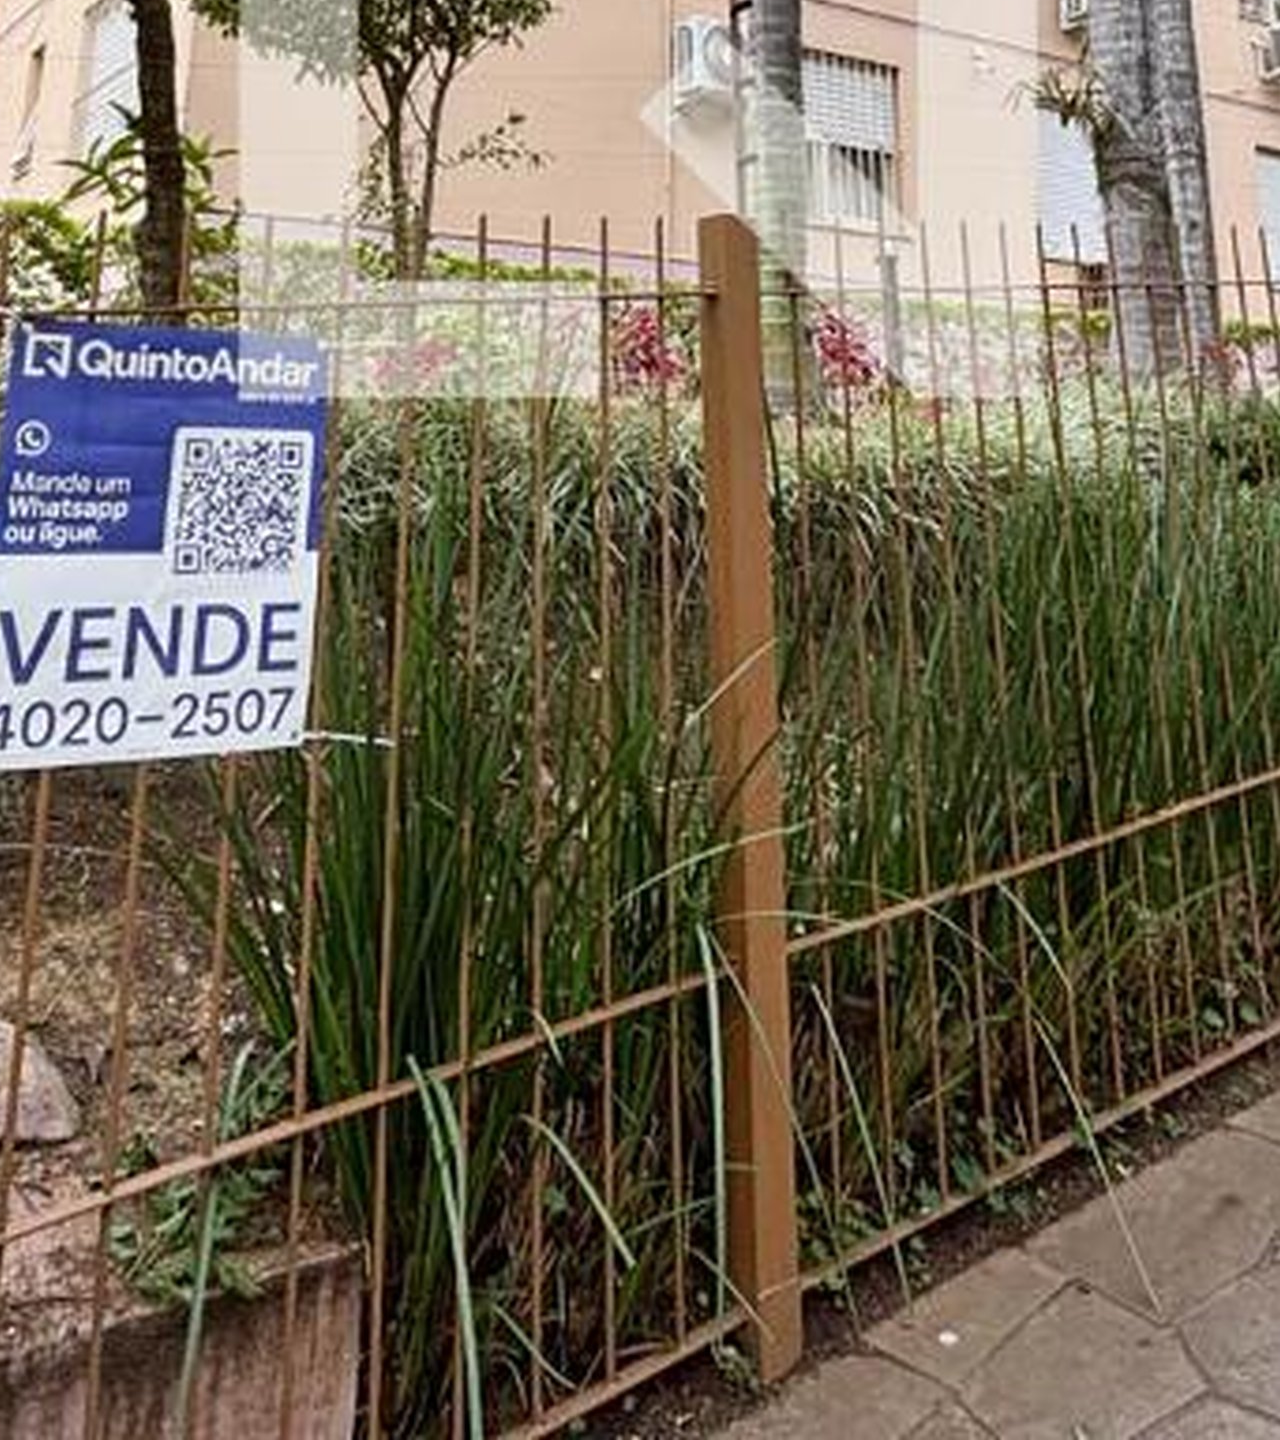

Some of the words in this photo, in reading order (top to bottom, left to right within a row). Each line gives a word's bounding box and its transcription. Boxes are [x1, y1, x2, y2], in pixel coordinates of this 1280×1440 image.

[77, 339, 320, 387] QuintoAndar
[10, 471, 91, 495] Mande
[94, 477, 132, 495] um
[7, 495, 129, 523] Whatsapp
[4, 525, 36, 543] ou
